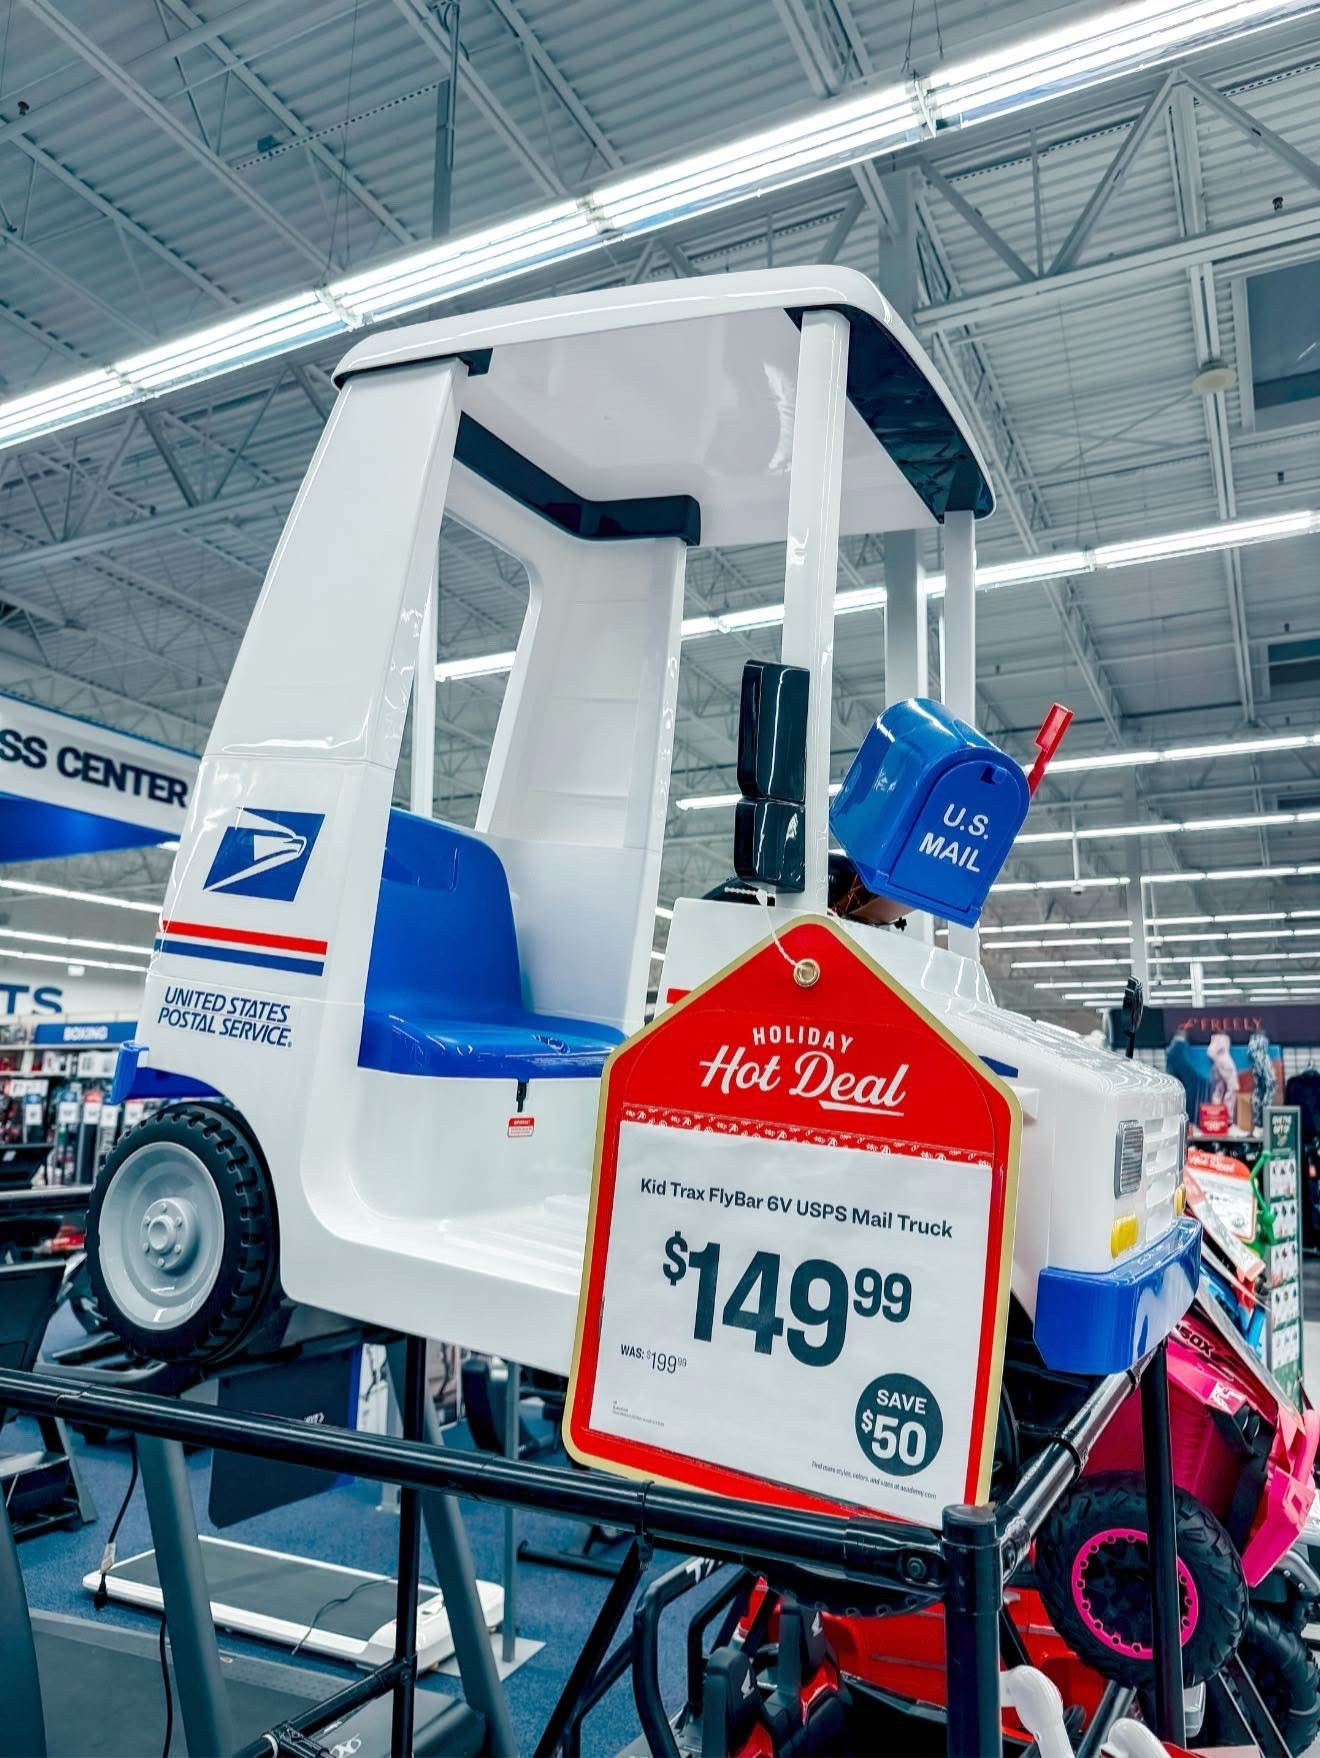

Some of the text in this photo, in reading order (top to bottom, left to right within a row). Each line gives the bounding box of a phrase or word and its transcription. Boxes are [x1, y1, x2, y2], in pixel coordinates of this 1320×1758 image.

[57, 746, 188, 808] CENTER
[943, 803, 989, 840] U.S.
[919, 832, 980, 873] MAIL
[158, 1007, 215, 1034] POSTAL
[164, 986, 290, 1023] UNITED STATES
[753, 1025, 854, 1054] HOLIDAY
[699, 1045, 910, 1107] Hot Deal
[640, 1178, 953, 1239] Kid Trax FlyBar 6V USPS Mail Truck
[620, 1343, 645, 1360] WAS:
[876, 1389, 927, 1415] SAVE
[861, 1409, 927, 1467] $50
